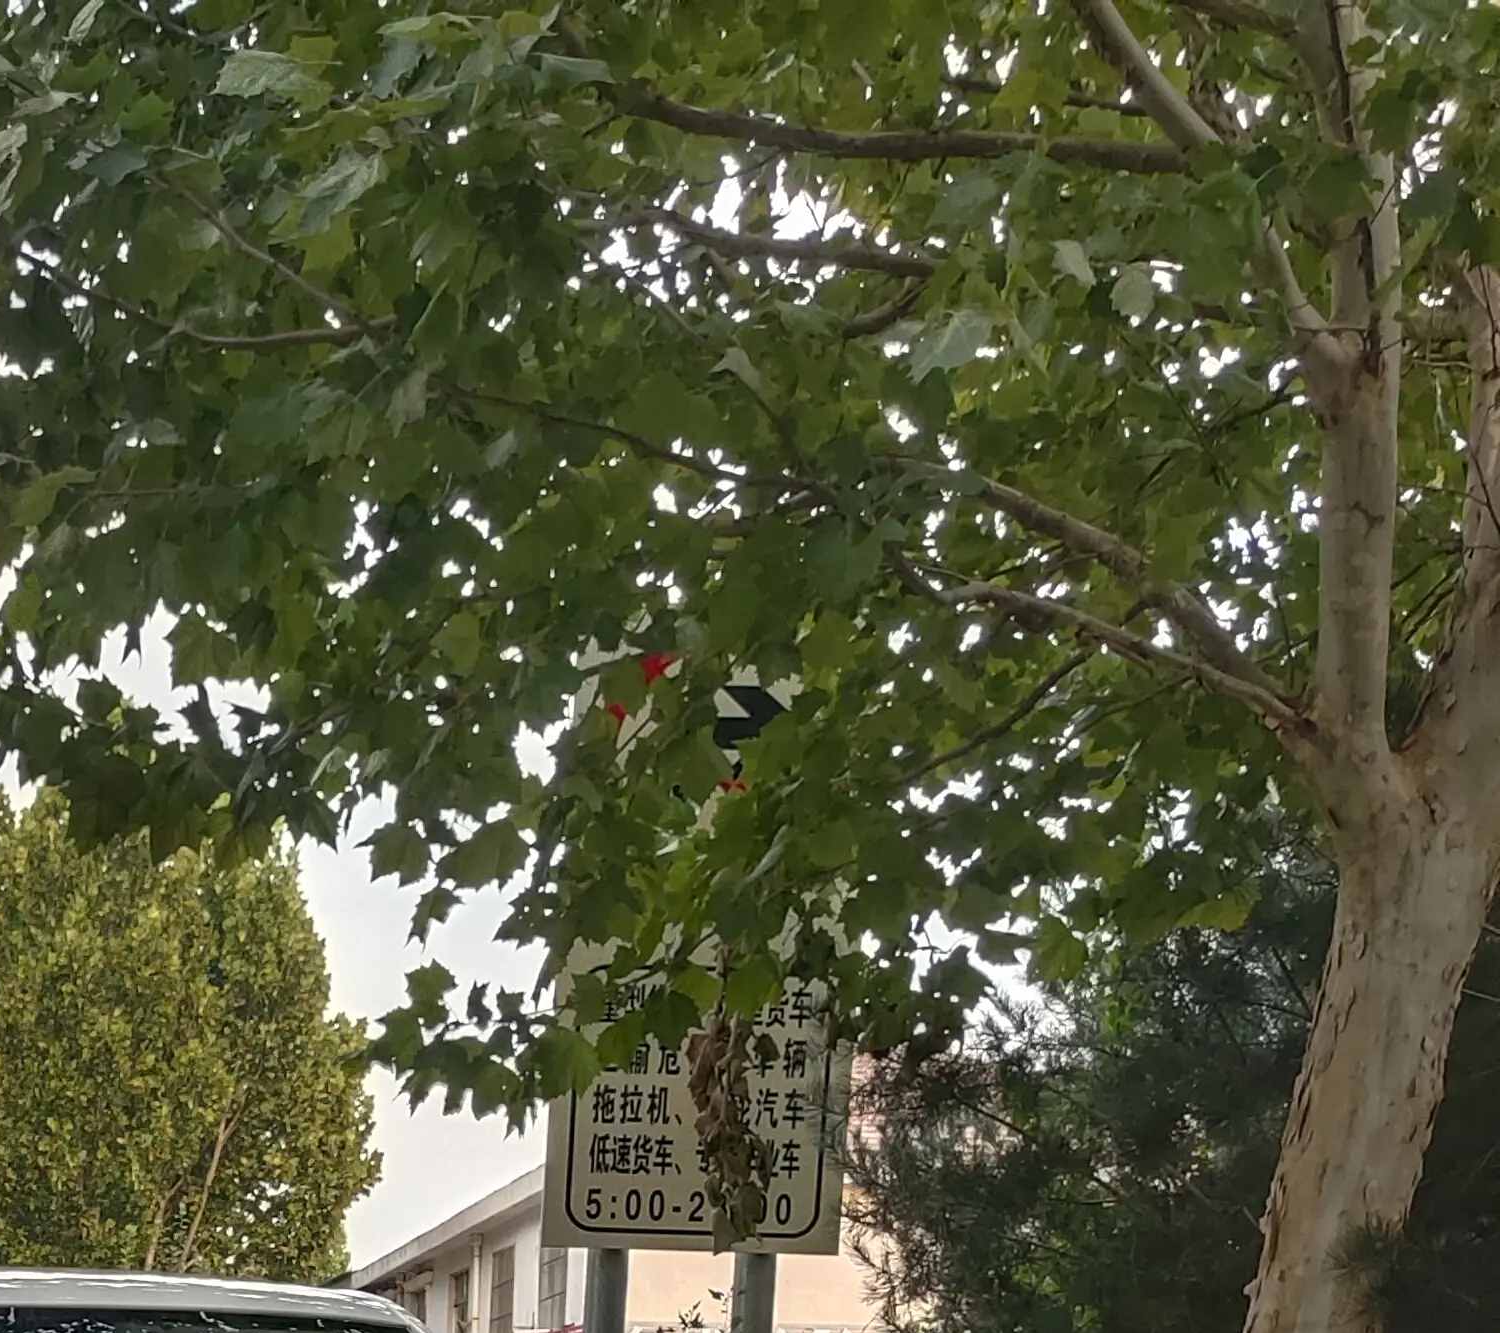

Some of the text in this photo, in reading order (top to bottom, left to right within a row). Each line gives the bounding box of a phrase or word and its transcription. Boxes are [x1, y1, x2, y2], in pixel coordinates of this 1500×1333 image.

[592, 1083, 805, 1130] 拖拉机、汽车
